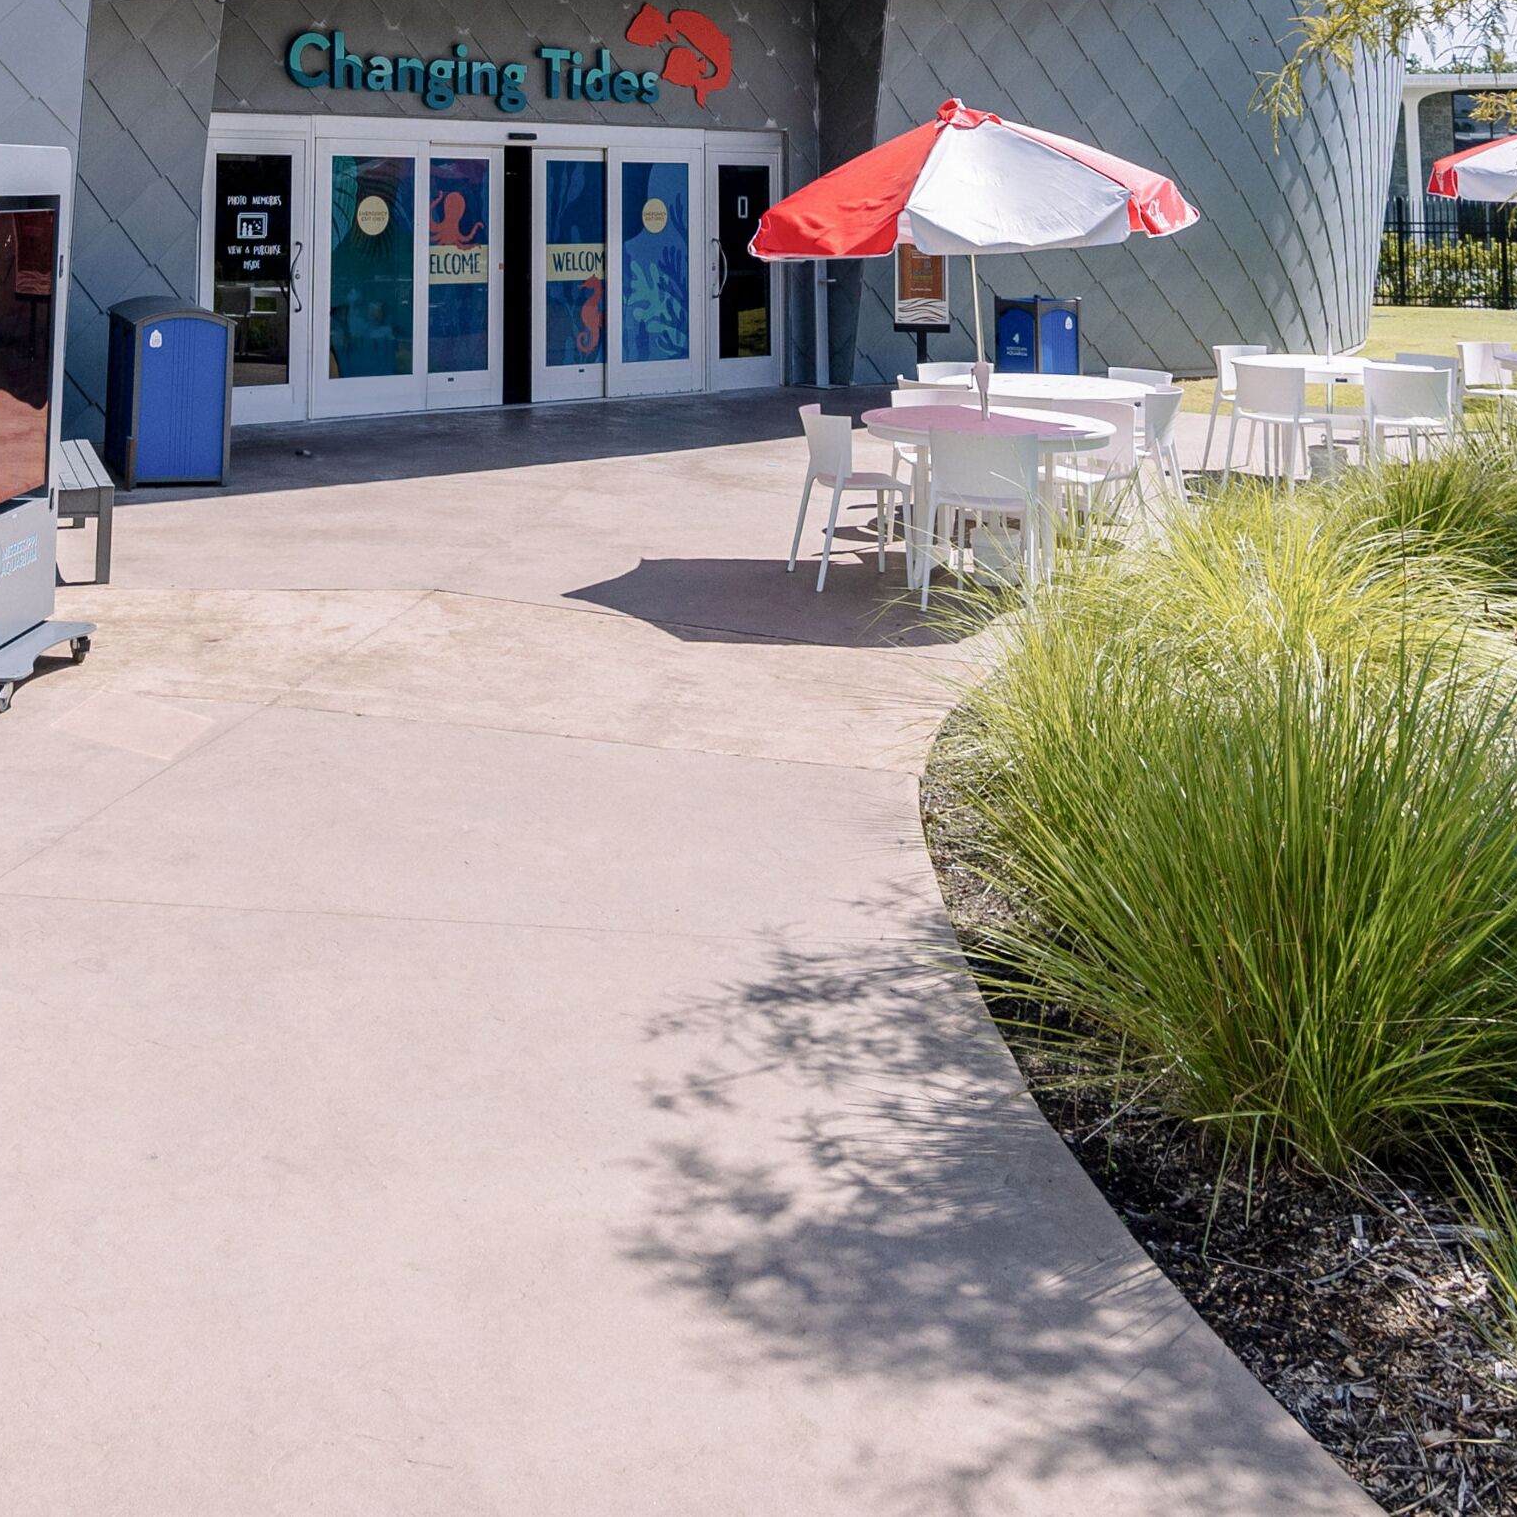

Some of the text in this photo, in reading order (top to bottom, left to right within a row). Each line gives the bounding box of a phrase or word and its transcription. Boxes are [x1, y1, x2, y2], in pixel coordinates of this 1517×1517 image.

[285, 31, 661, 113] Changing Tides
[227, 195, 247, 206] PHOTO
[227, 245, 243, 256] VIEW
[552, 250, 605, 273] WELCOM
[429, 252, 481, 275] ELCOME
